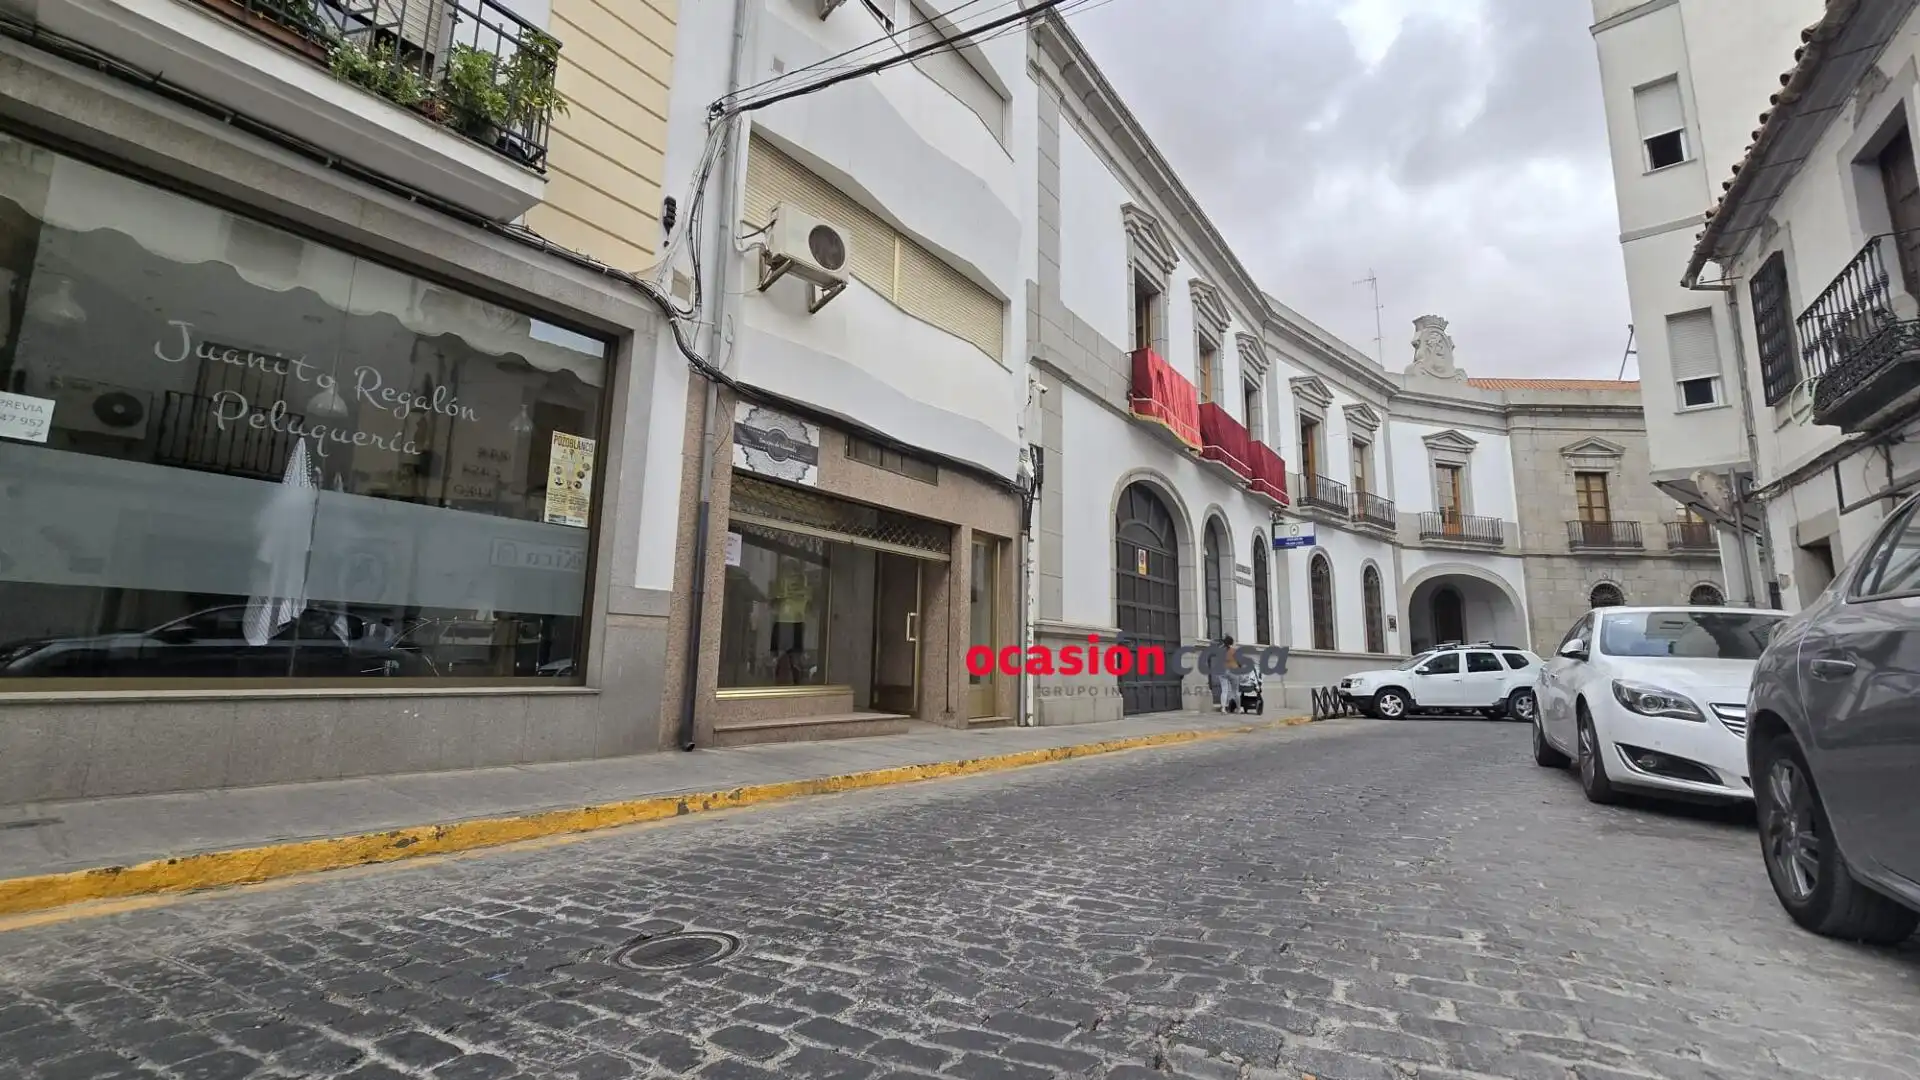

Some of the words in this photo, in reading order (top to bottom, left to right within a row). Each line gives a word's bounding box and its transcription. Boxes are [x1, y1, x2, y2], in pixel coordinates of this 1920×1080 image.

[154, 320, 335, 388] Juanito
[354, 366, 481, 422] Regalón
[212, 390, 422, 457] Peluquería
[554, 435, 593, 452] POZOBLANCO
